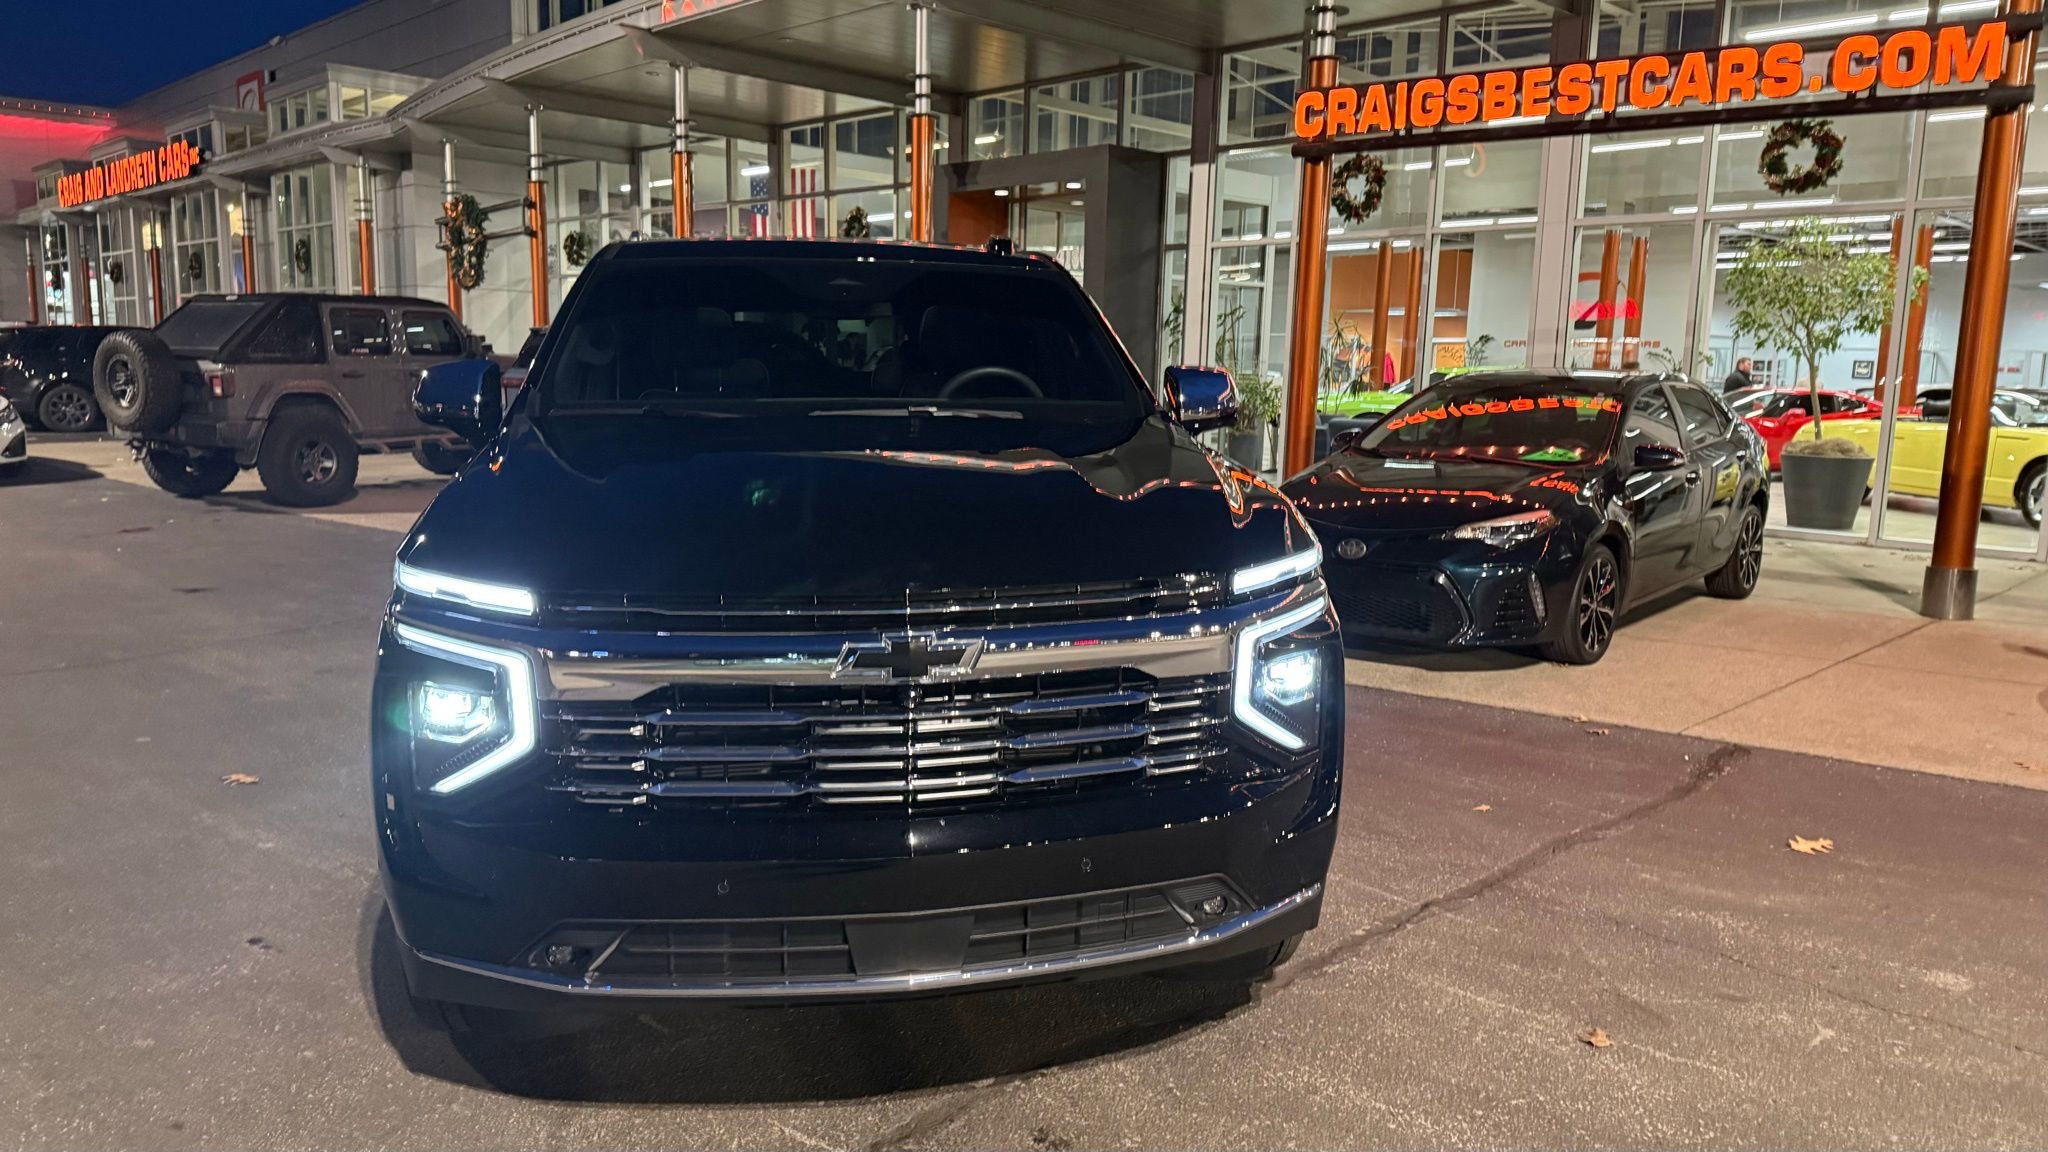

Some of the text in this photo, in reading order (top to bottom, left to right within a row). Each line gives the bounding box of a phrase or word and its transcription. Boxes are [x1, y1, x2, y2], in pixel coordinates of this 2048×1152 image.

[1295, 22, 2008, 139] CRAIGSBESTCARS.COM
[57, 172, 83, 208] CRAIG
[84, 166, 104, 202] AND
[105, 150, 157, 196] LANDRETH
[158, 139, 190, 182] CARS
